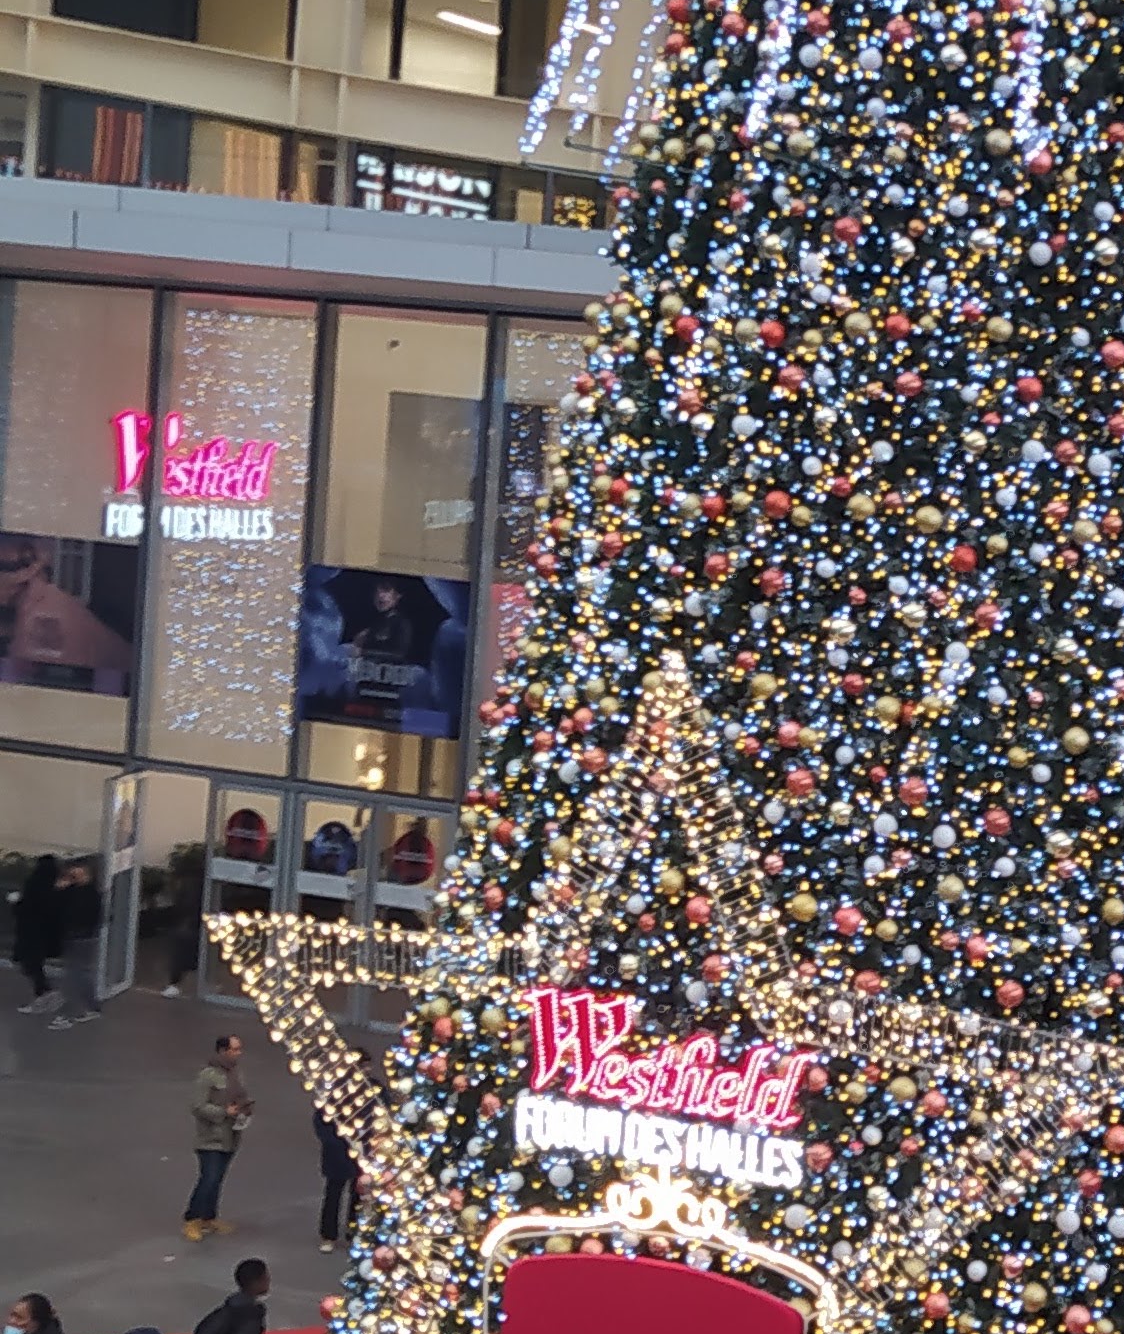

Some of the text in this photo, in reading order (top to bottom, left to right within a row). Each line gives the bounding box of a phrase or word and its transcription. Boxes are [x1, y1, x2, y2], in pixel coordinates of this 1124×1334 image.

[521, 985, 822, 1130] Westfield
[514, 1095, 804, 1190] FORUM DES HALLES
